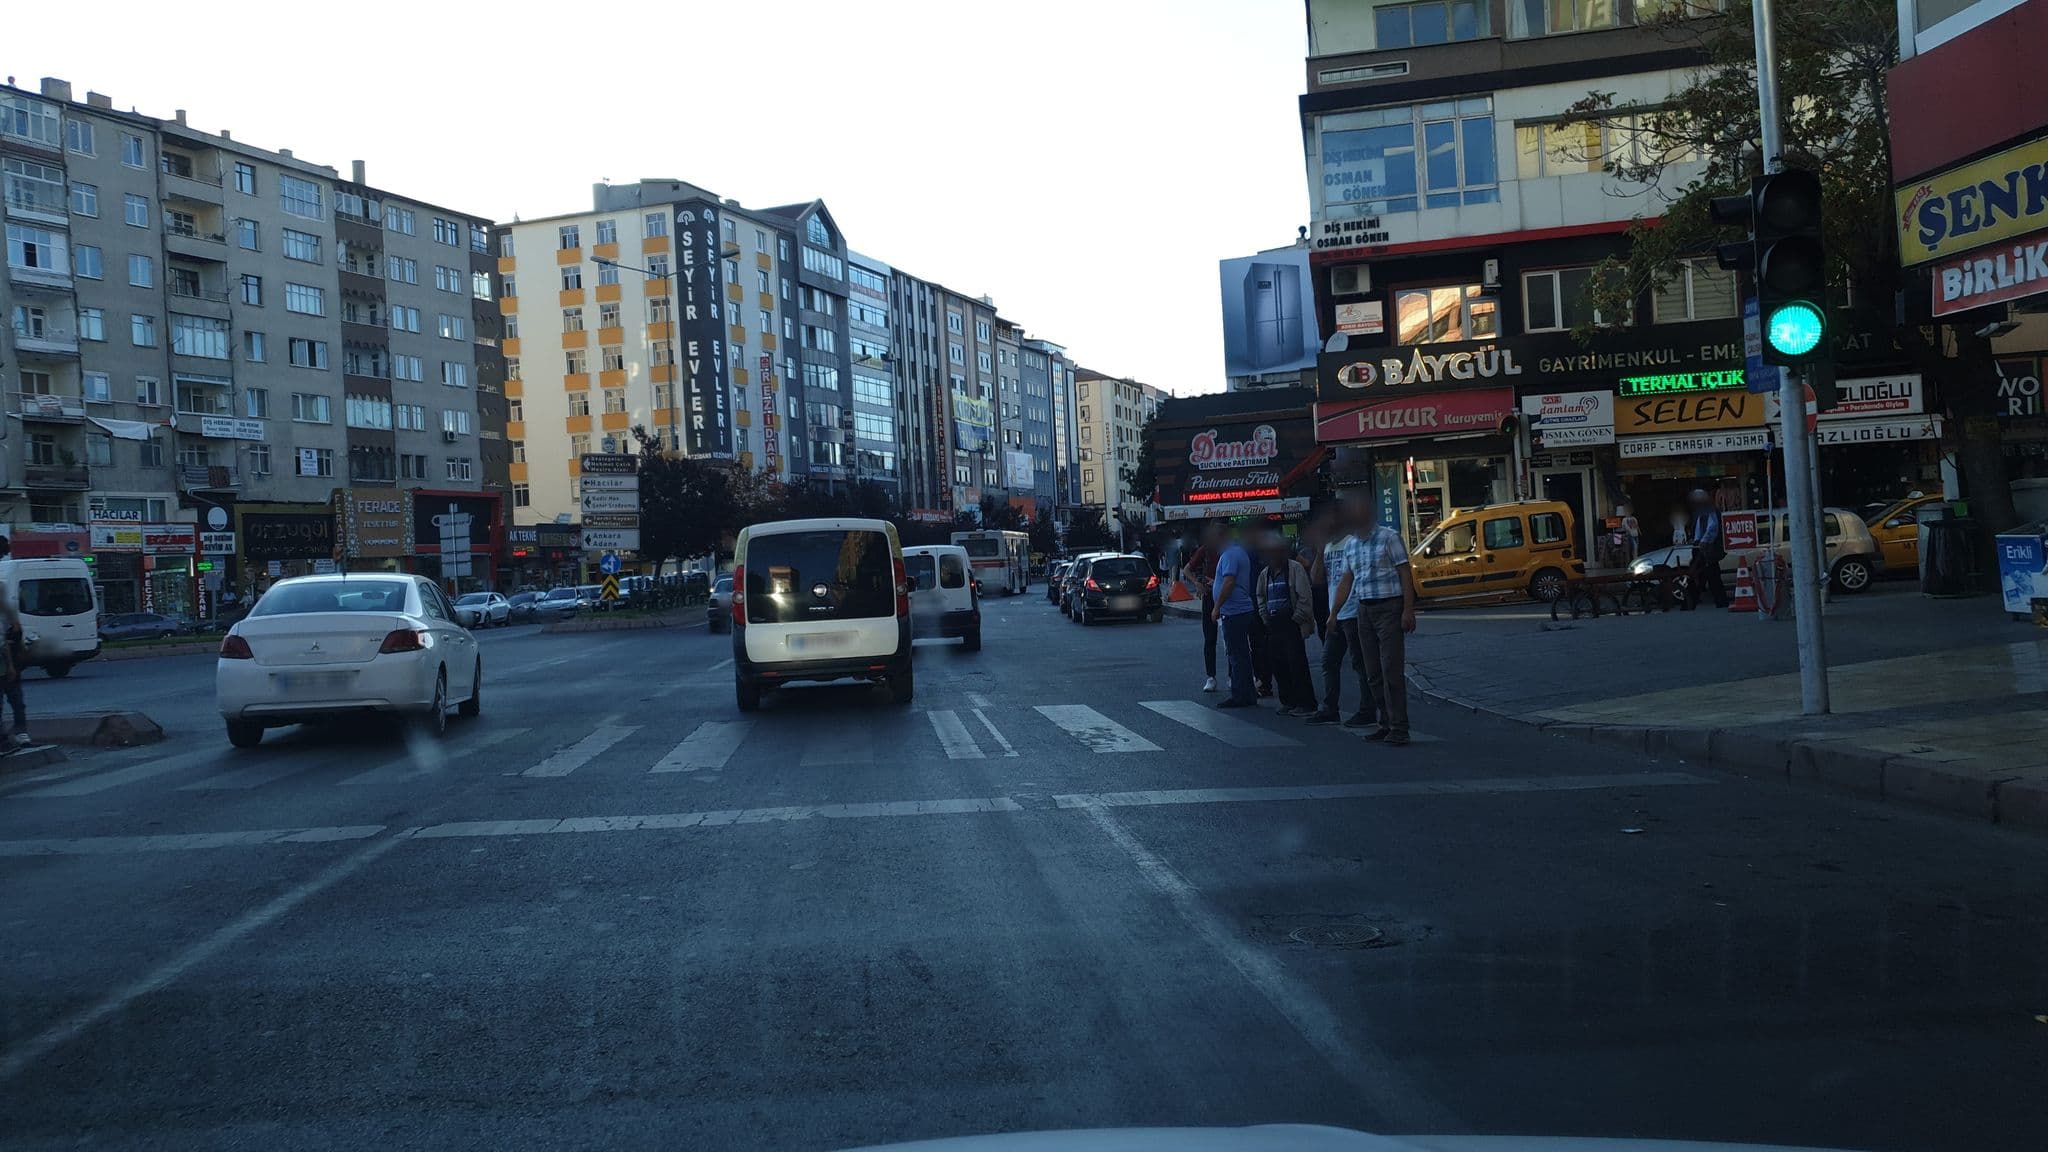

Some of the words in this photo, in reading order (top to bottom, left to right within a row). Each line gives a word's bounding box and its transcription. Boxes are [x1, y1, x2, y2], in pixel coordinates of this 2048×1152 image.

[1325, 169, 1373, 187] OSMAN
[1343, 184, 1388, 201] GÖNEN
[1324, 221, 1341, 235] DİŞ
[1343, 216, 1381, 232] HEKİMİ
[1317, 235, 1352, 248] OSMAN
[1355, 230, 1389, 245] GÖNEN
[682, 231, 697, 321] SEYİR
[706, 230, 718, 320] SEYİR
[1382, 344, 1522, 386] BAYGÜL
[1540, 347, 1681, 374] GAYRİMENKUL
[1630, 373, 1698, 392] TERMAL
[688, 340, 704, 448] EVLERİ
[713, 339, 725, 446] EVLERİ
[1358, 406, 1439, 434] HUZUR
[1634, 395, 1745, 426] SELEN
[1541, 430, 1575, 440] OSMAN
[1577, 427, 1612, 438] GÖNEN
[1200, 460, 1220, 469] SUCUK
[1233, 458, 1267, 467] PASTIRMA
[590, 479, 623, 487] Hacılar
[1191, 475, 1245, 490] Pastırmacı
[1246, 470, 1279, 486] Fatih
[93, 510, 139, 520] HACILAR
[1726, 520, 1754, 534] 2.NOTER
[2005, 545, 2033, 559] Erikli
